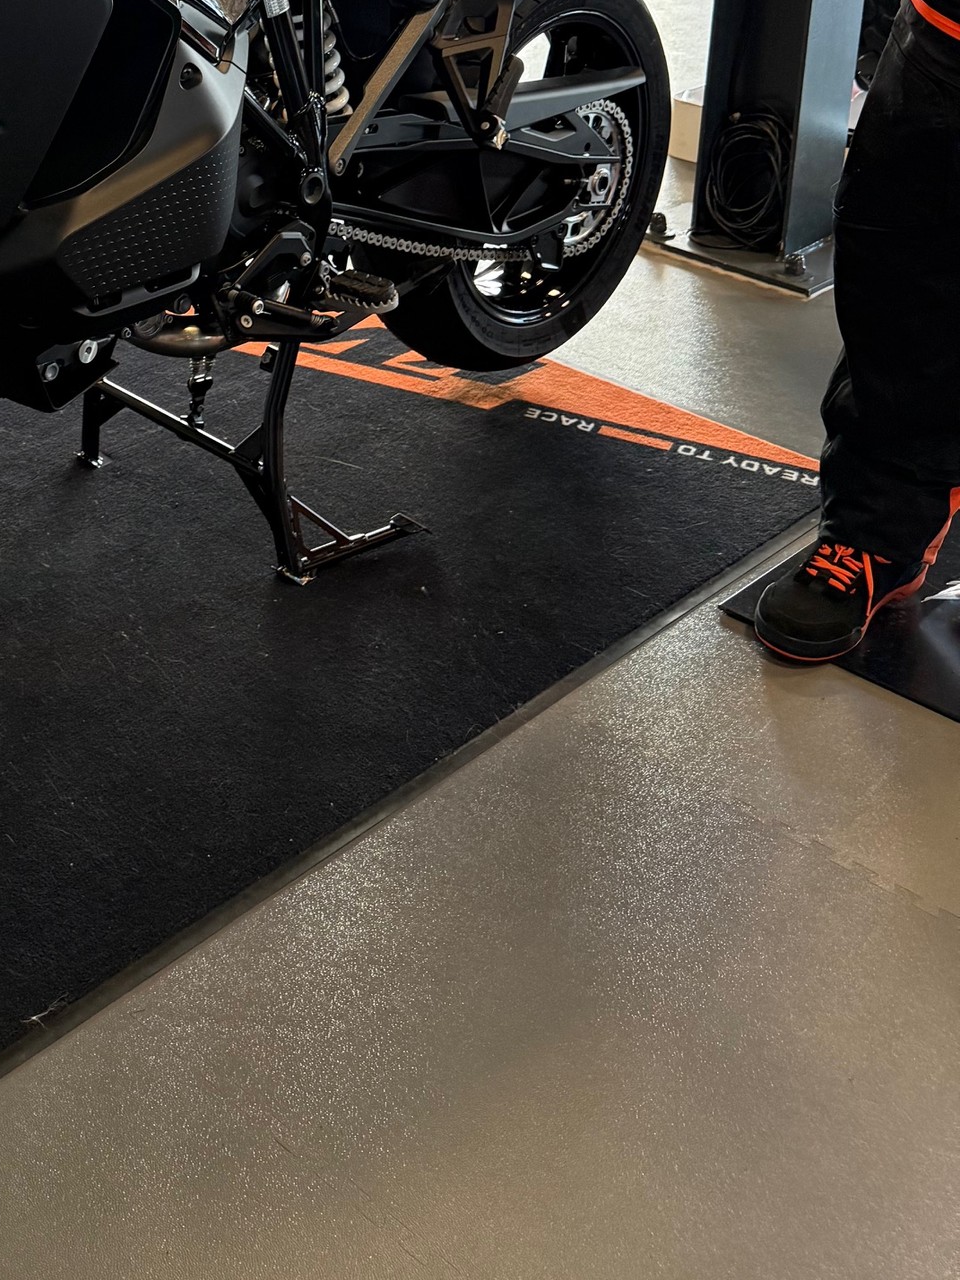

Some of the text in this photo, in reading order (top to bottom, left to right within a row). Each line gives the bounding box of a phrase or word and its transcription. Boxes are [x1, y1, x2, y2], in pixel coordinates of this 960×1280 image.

[524, 407, 820, 487] READY TO RACE
